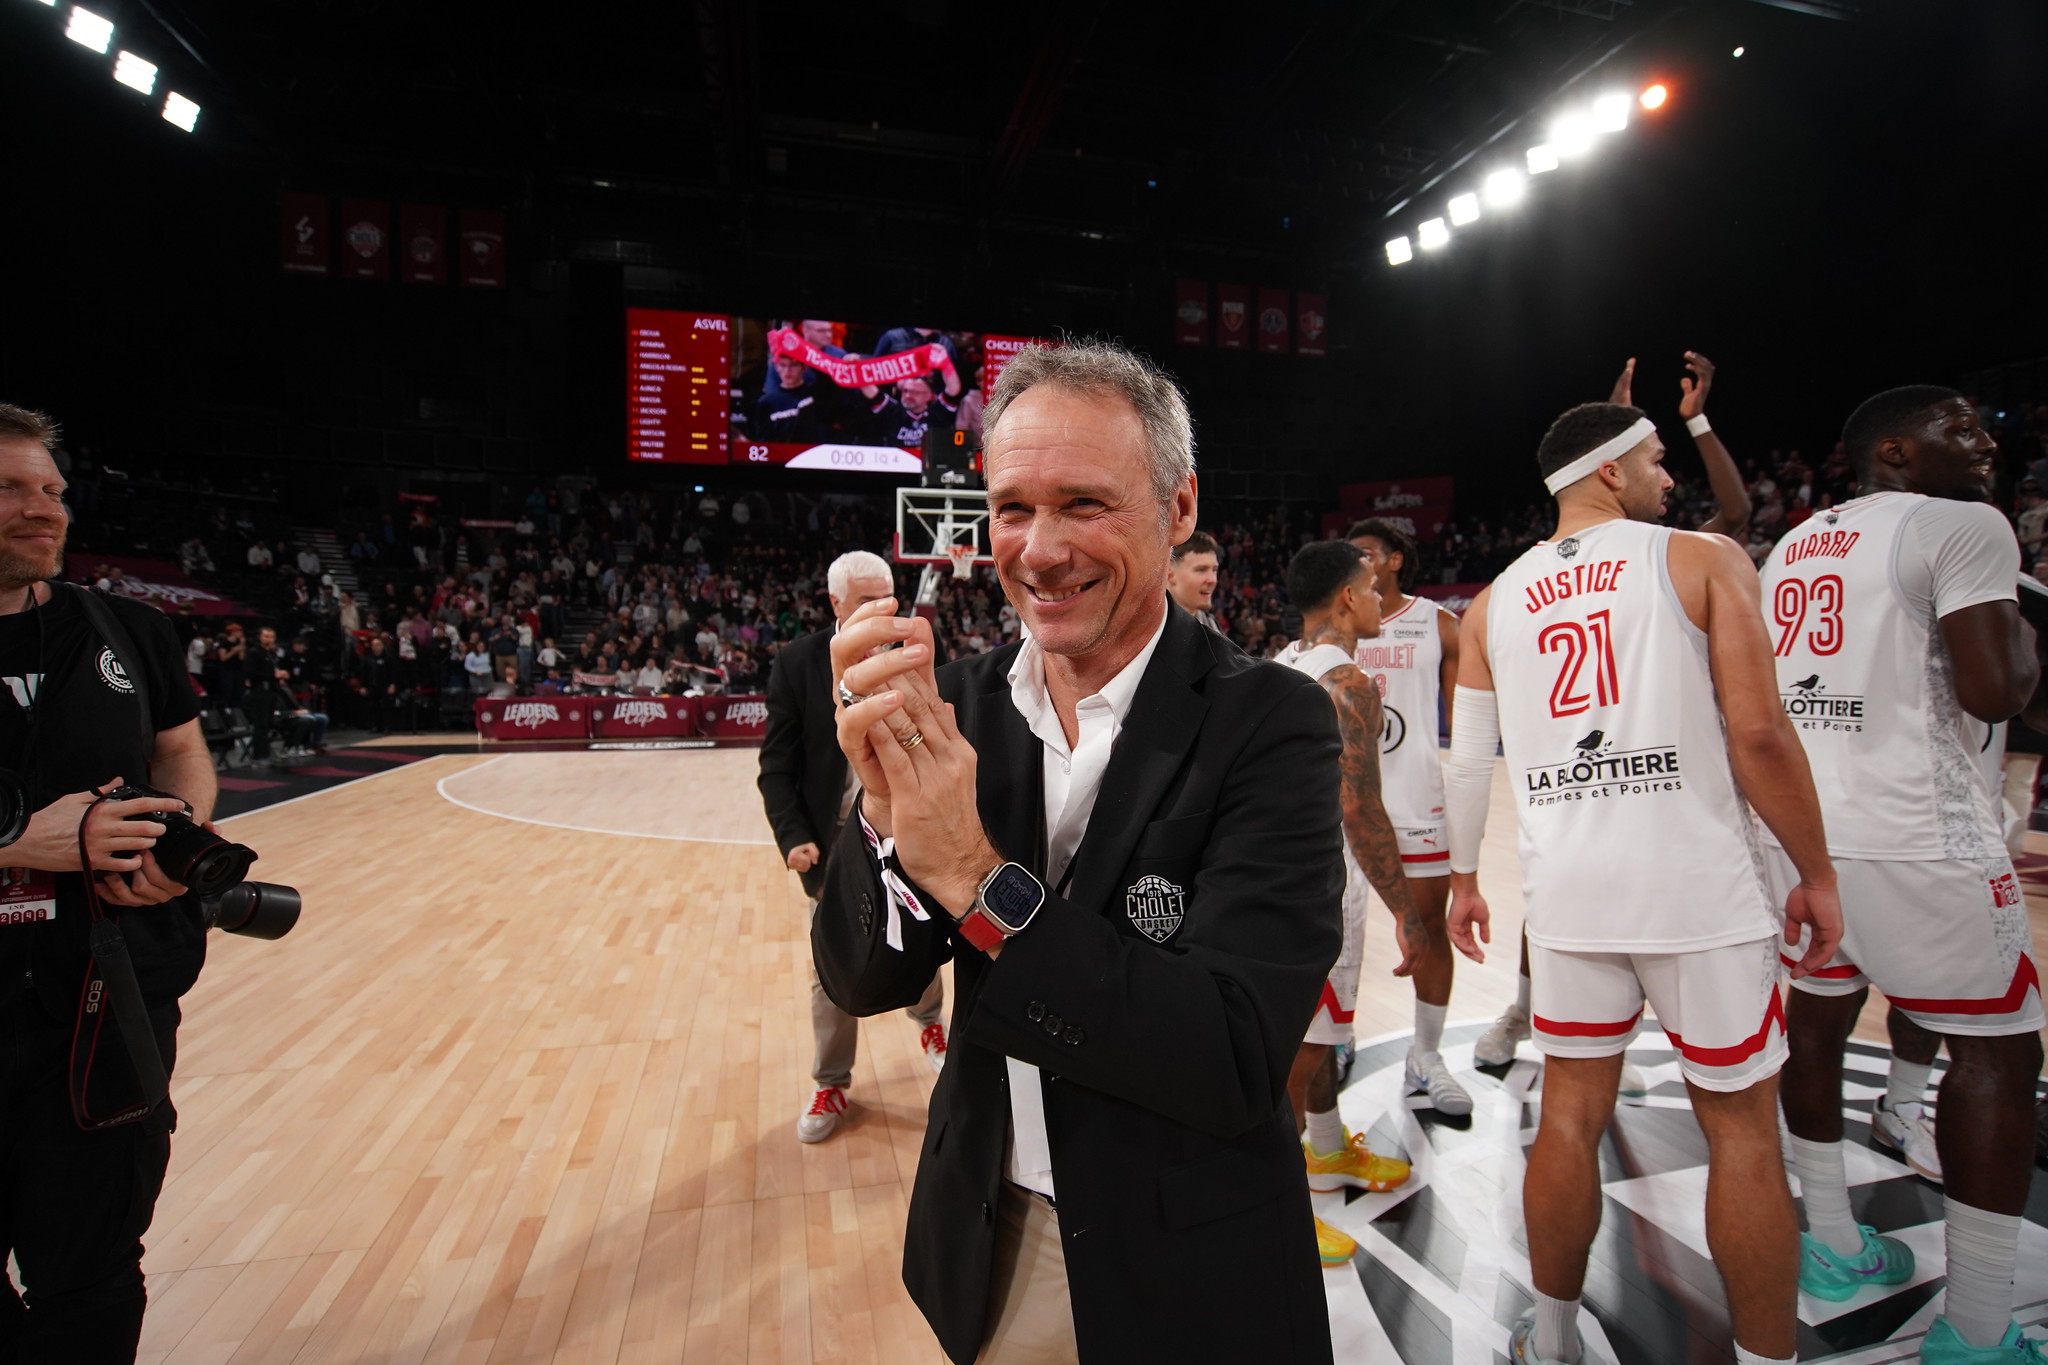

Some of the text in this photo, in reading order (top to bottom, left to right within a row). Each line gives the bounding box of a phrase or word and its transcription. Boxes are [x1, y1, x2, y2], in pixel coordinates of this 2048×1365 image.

[694, 318, 728, 331] ASVEL
[861, 353, 917, 383] CHOLET
[954, 431, 965, 446] 0
[749, 446, 768, 461] 82
[831, 450, 864, 465] 0:00
[1557, 541, 1580, 554] CHOLET
[1786, 530, 1860, 566] DIARRA
[1526, 560, 1627, 613] JUSTICE
[1774, 574, 1843, 657] 93
[1538, 609, 1619, 718] 21
[503, 703, 560, 721] LEADERS
[613, 701, 668, 719] LEADERS
[725, 702, 768, 720] LEADE
[1783, 699, 1863, 717] LOTTIERE
[1528, 752, 1679, 791] LA BLOTTIERE
[1592, 787, 1609, 798] et
[1620, 780, 1682, 796] Poires
[1126, 892, 1185, 918] CHOLET
[1, 910, 44, 922] 2 3 4 5
[1141, 919, 1175, 929] BASKET
[87, 980, 103, 1013] EOS
